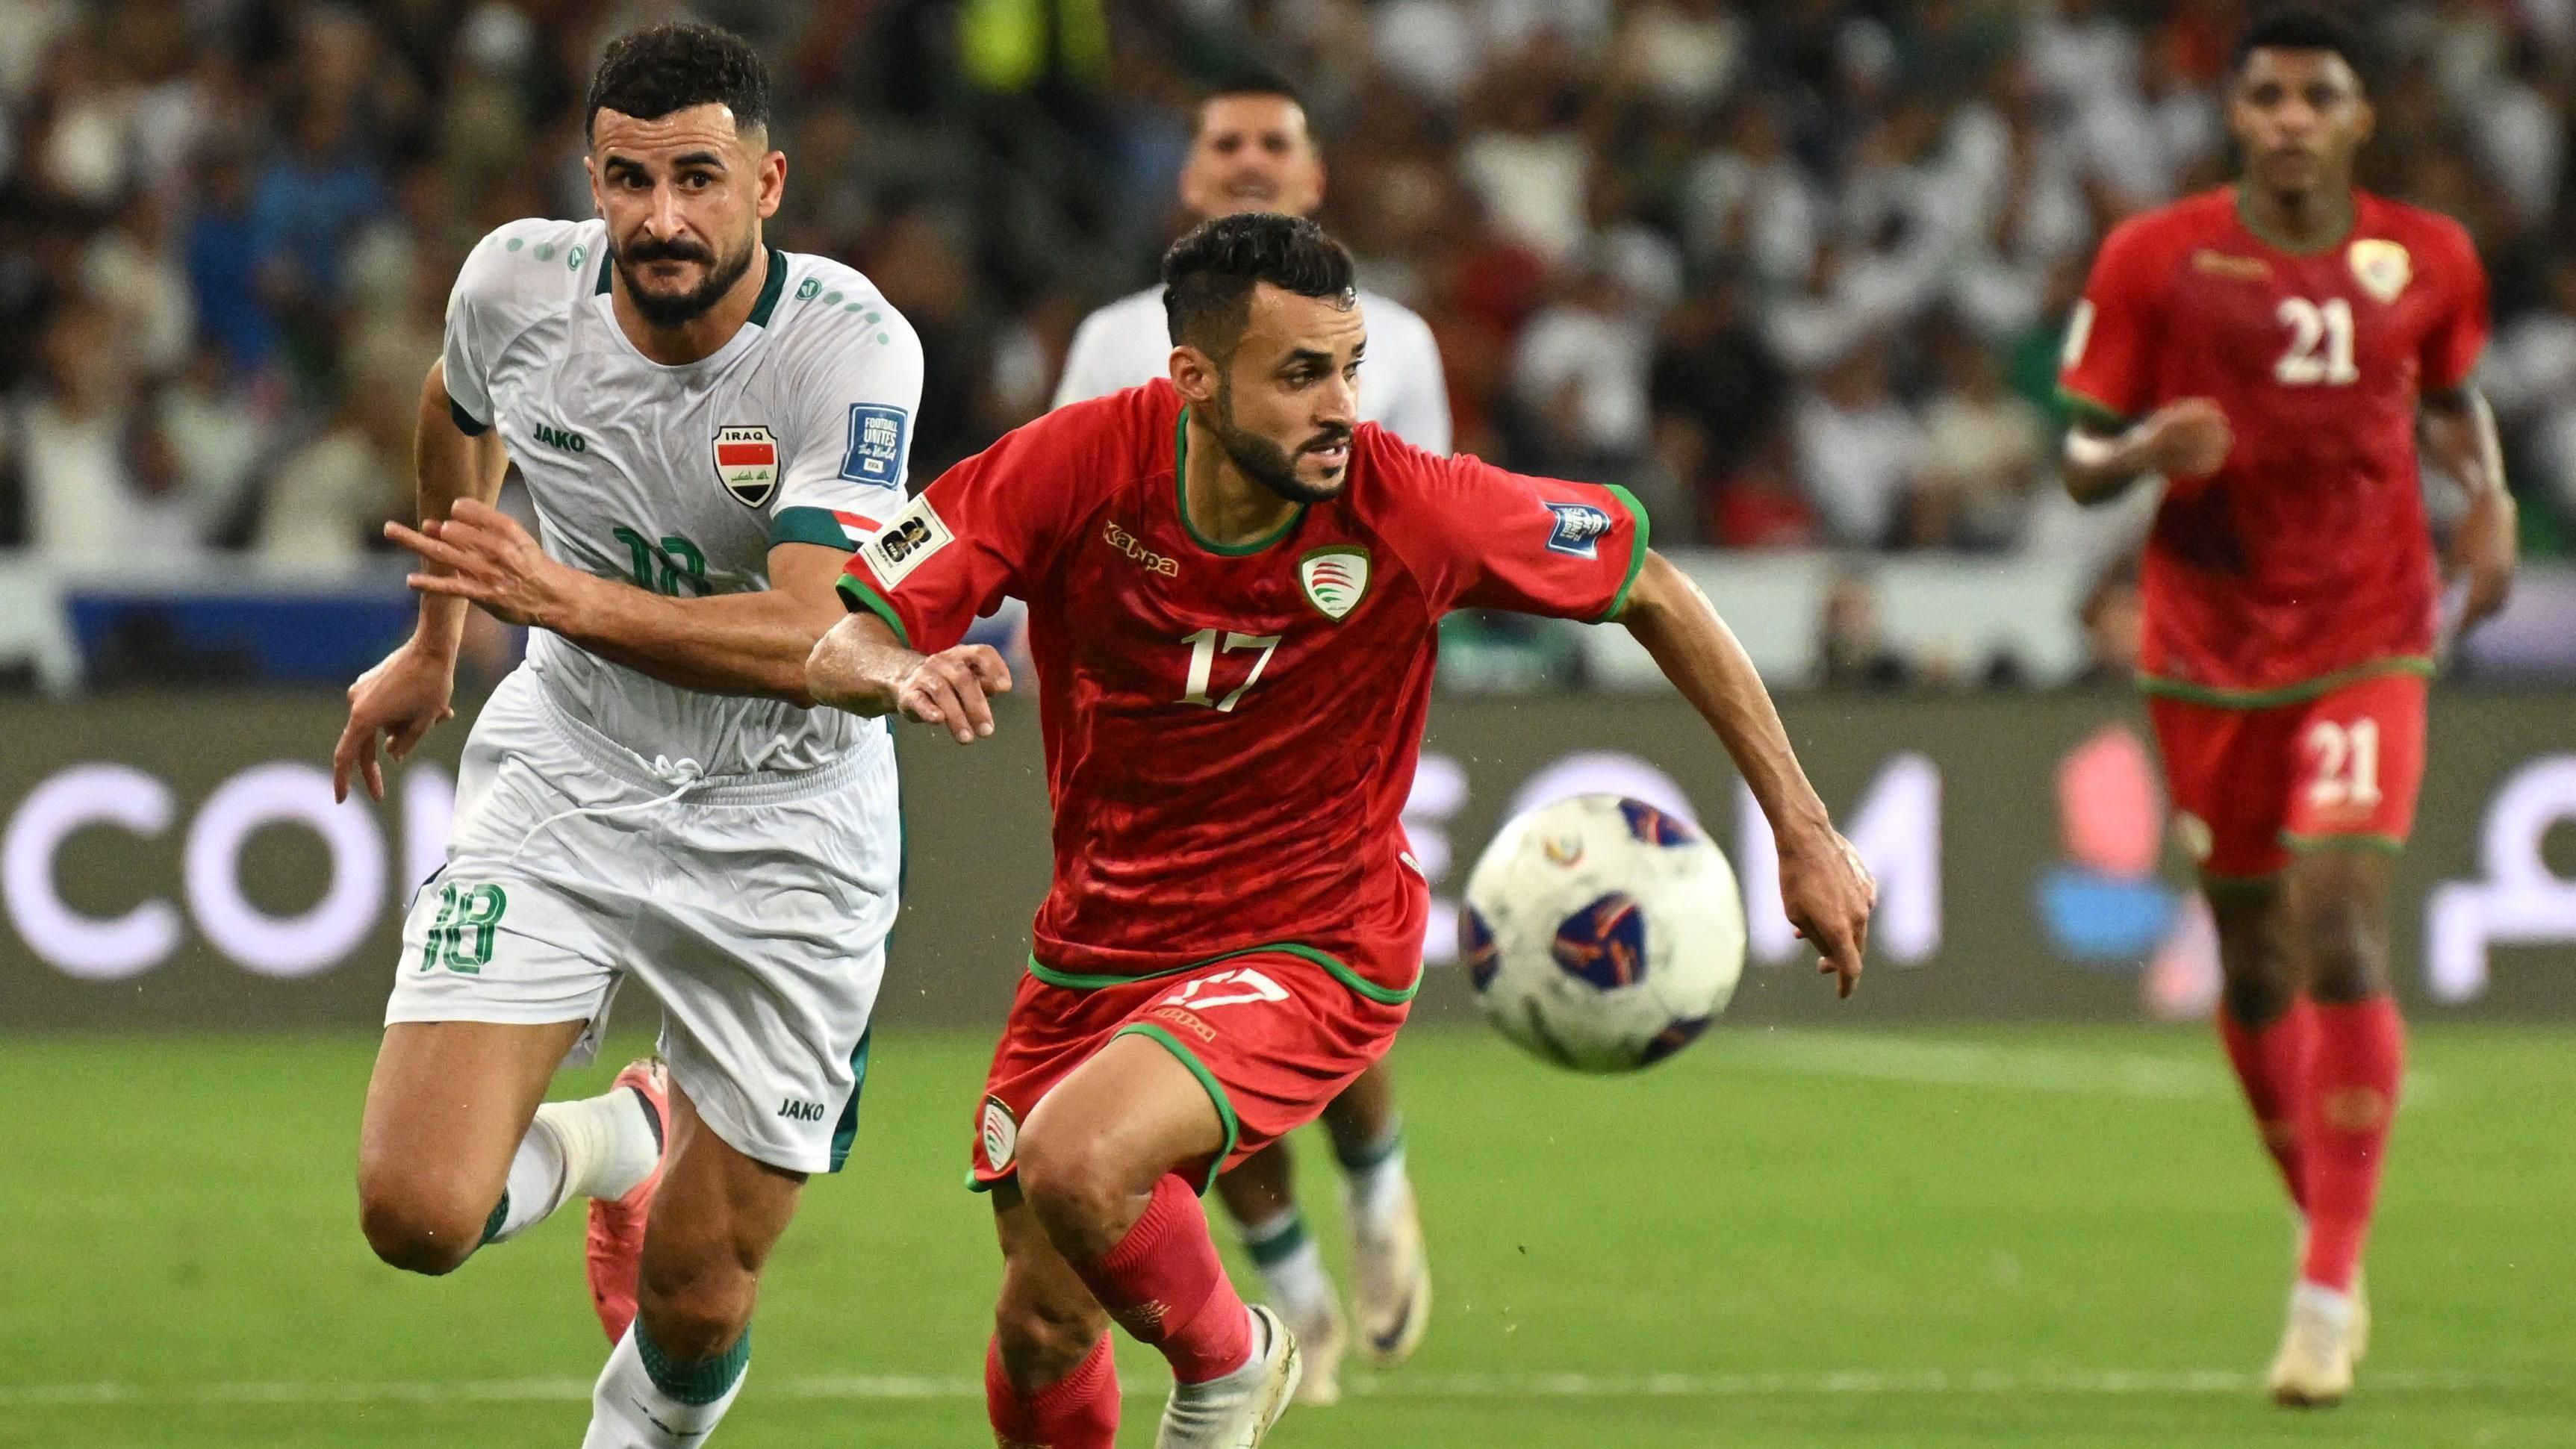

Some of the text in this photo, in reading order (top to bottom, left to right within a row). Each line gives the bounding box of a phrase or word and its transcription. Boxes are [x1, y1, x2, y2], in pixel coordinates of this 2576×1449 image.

[2275, 297, 2358, 385] 21
[533, 423, 585, 453] JAKO
[726, 431, 763, 440] IRAQ
[863, 429, 897, 447] UNITES
[1173, 628, 1282, 713] 17
[2307, 718, 2380, 806] 21
[420, 881, 507, 974] 18
[1158, 967, 1290, 1010] 17
[777, 1097, 825, 1121] JAKO
